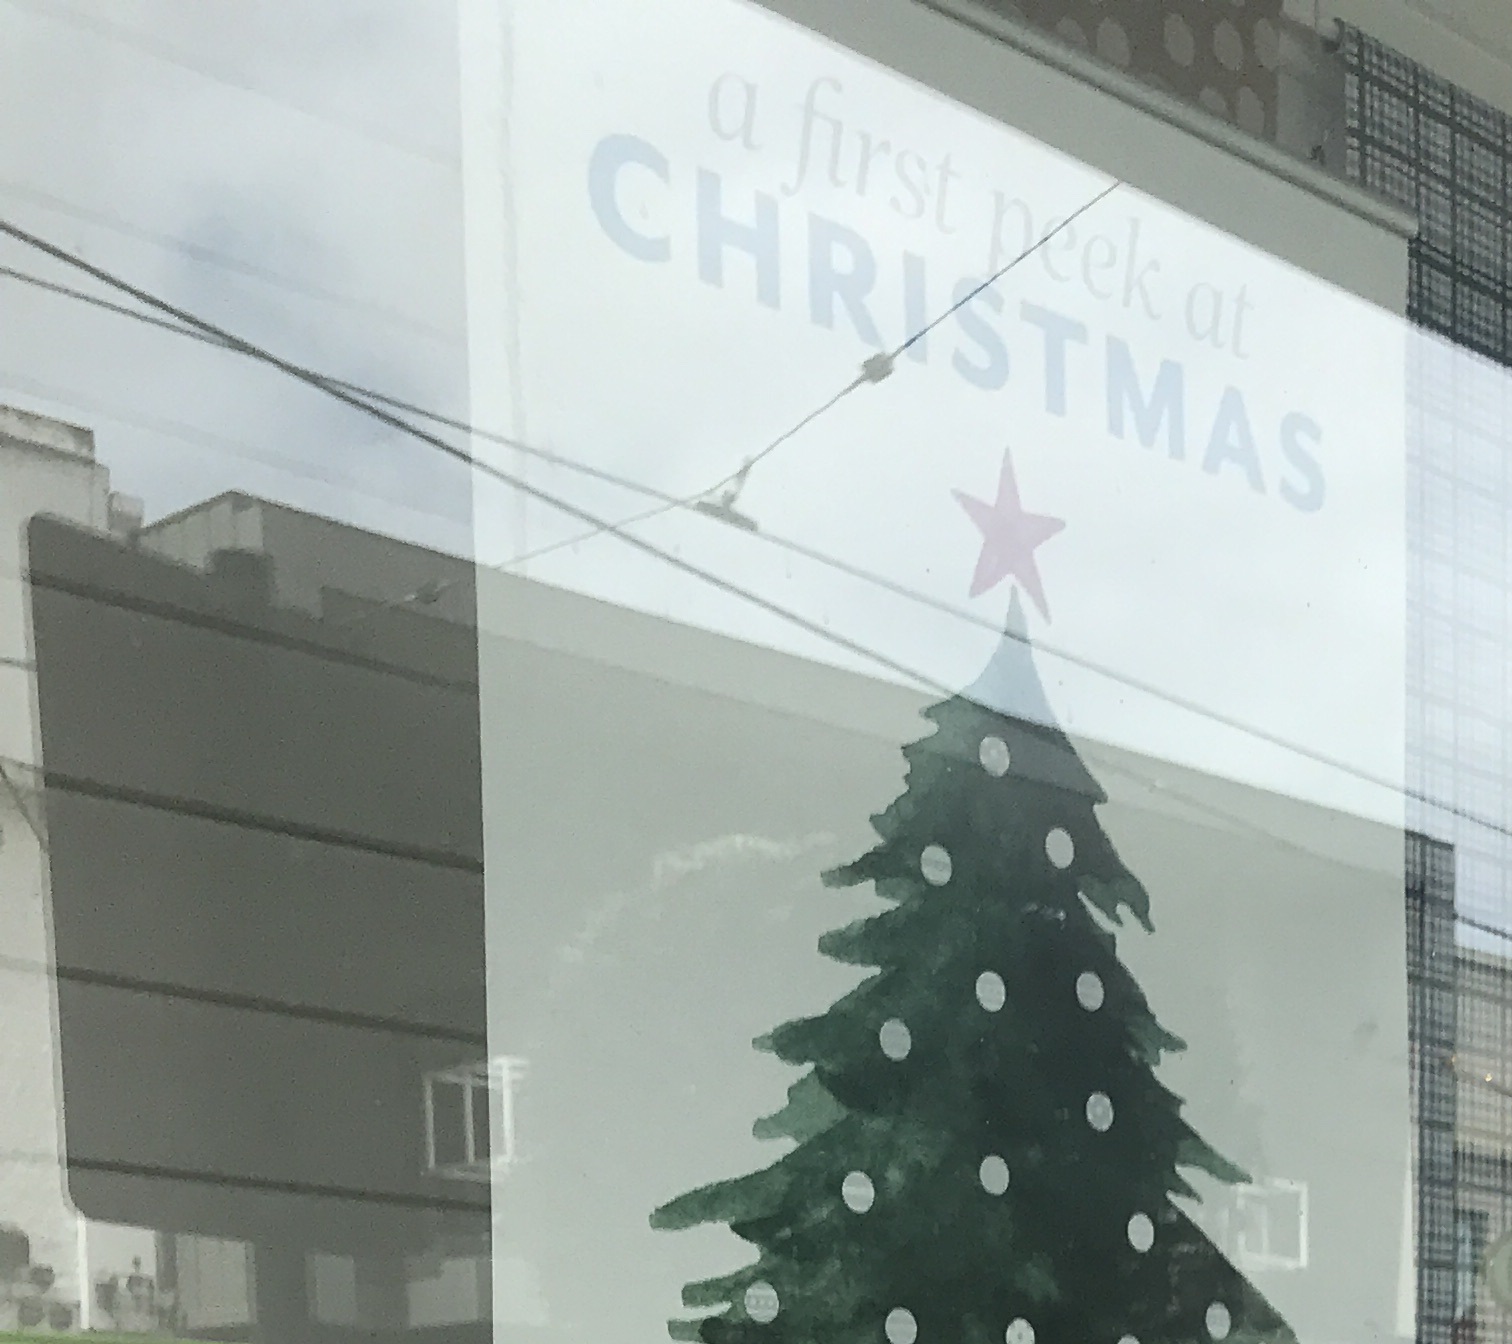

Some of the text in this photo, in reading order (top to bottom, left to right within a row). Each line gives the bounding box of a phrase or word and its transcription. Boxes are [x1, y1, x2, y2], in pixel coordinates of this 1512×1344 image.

[587, 131, 1327, 515] CHRISTMAS
[709, 70, 1256, 360] a first peek at
